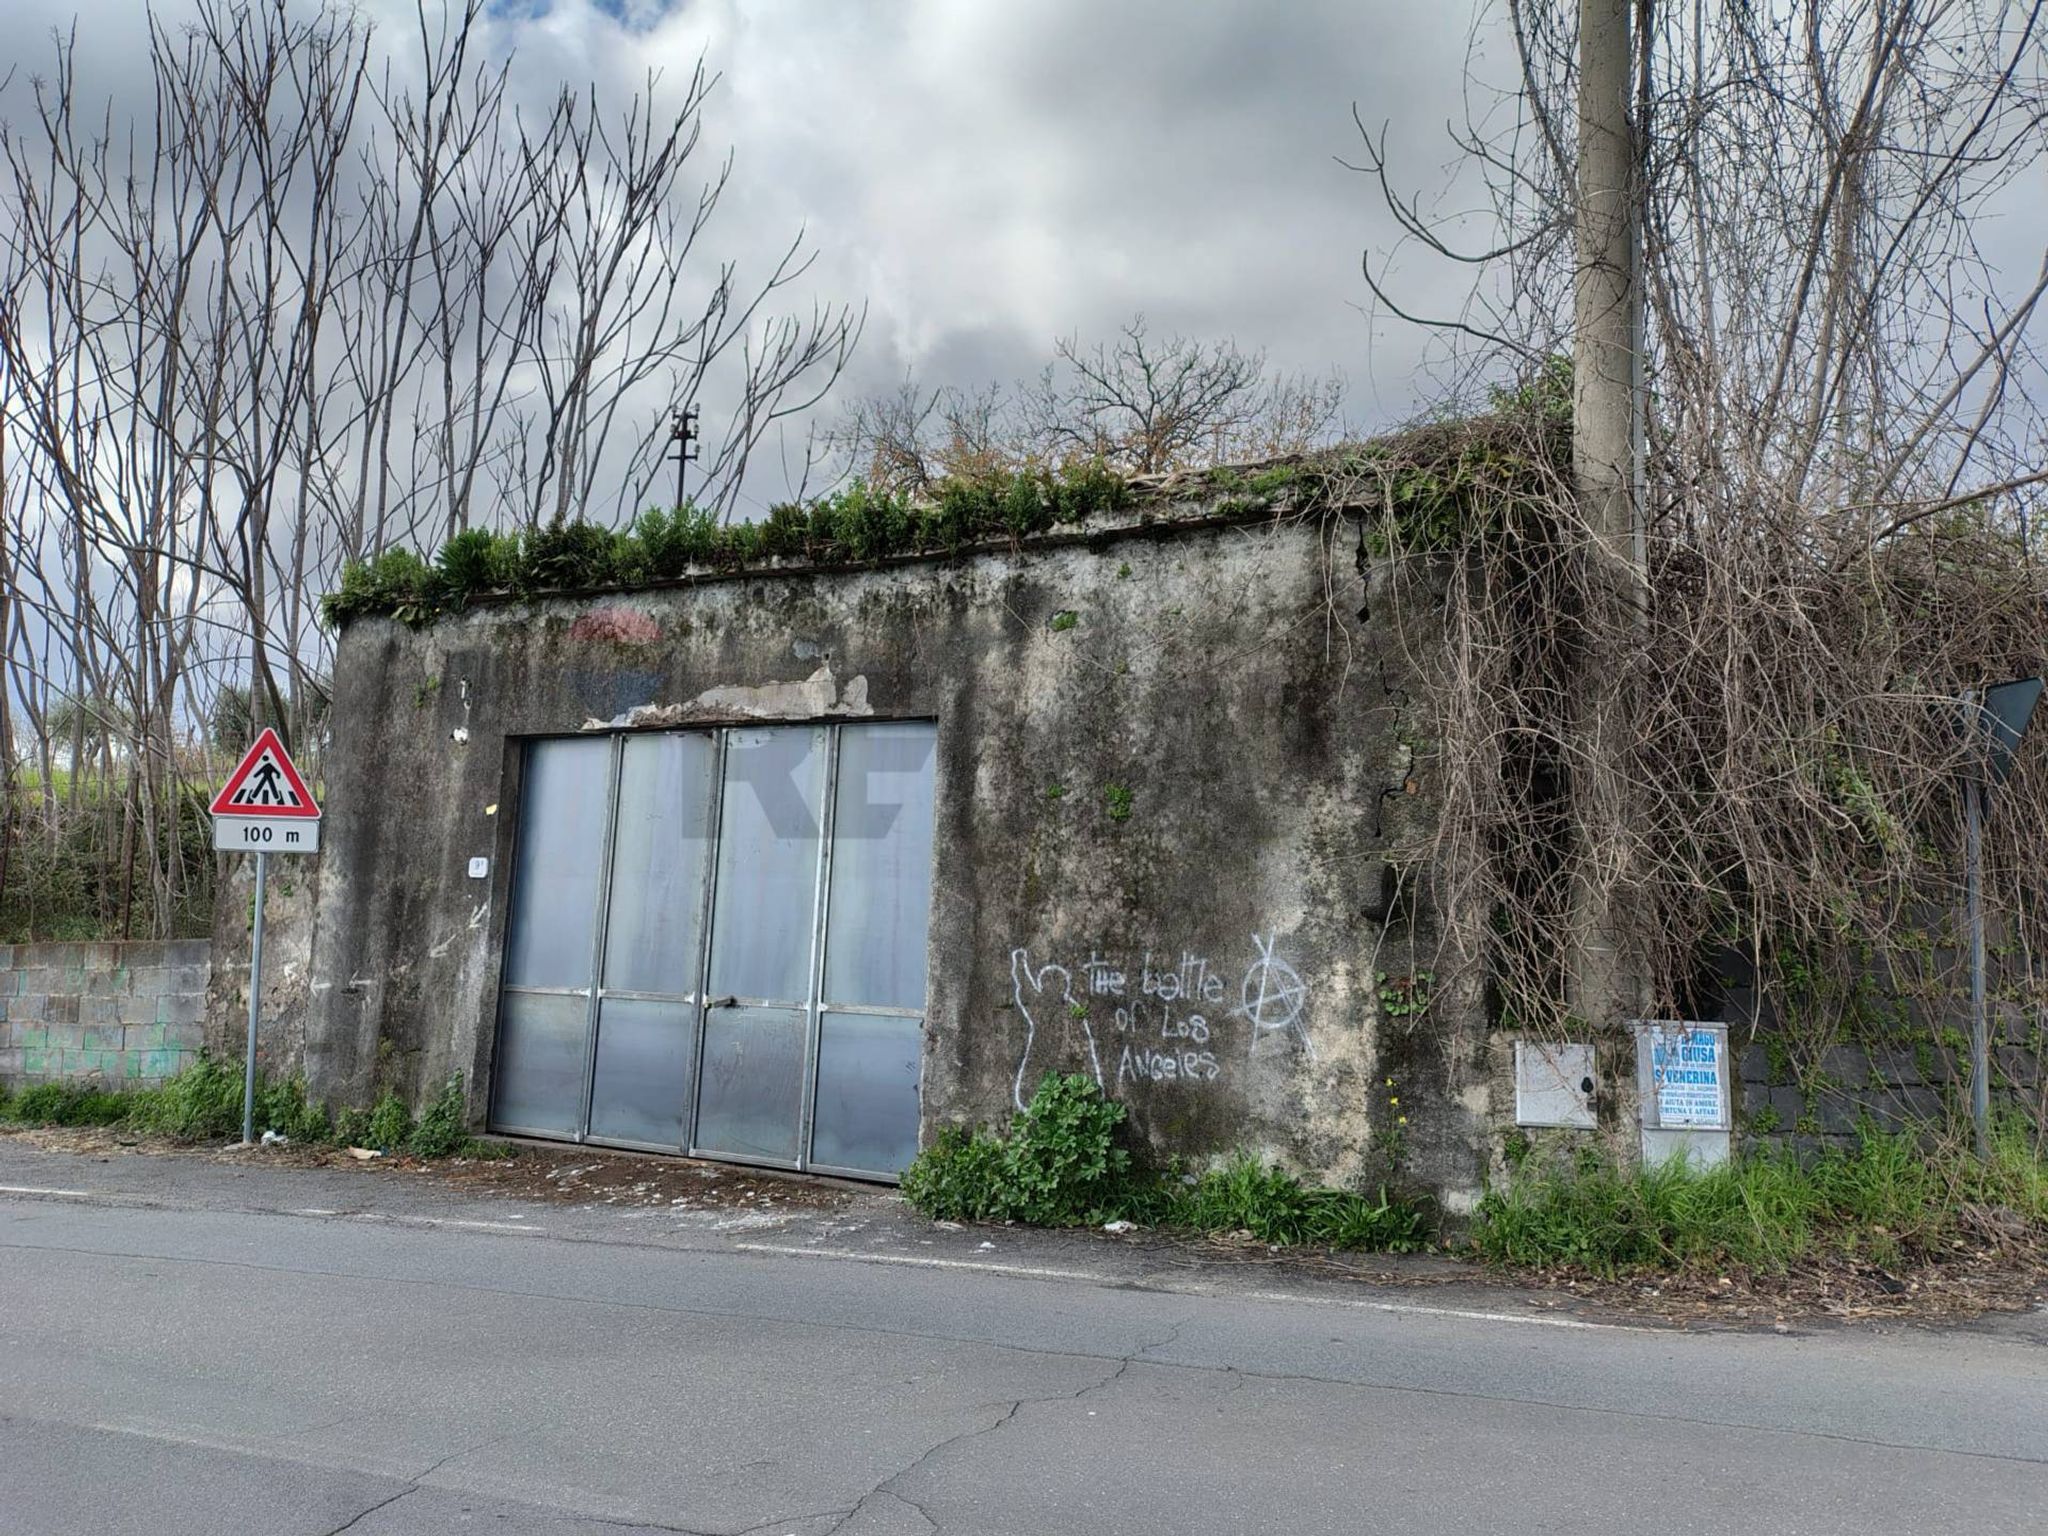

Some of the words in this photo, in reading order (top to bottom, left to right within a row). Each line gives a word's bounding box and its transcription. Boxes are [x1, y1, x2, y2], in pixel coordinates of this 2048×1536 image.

[243, 826, 272, 842] 100
[286, 831, 299, 842] m
[1115, 1000, 1147, 1033] of
[1681, 1046, 1716, 1063] GIUSA
[1666, 1069, 1717, 1085] VENERINA
[1665, 1098, 1684, 1107] AIUTA
